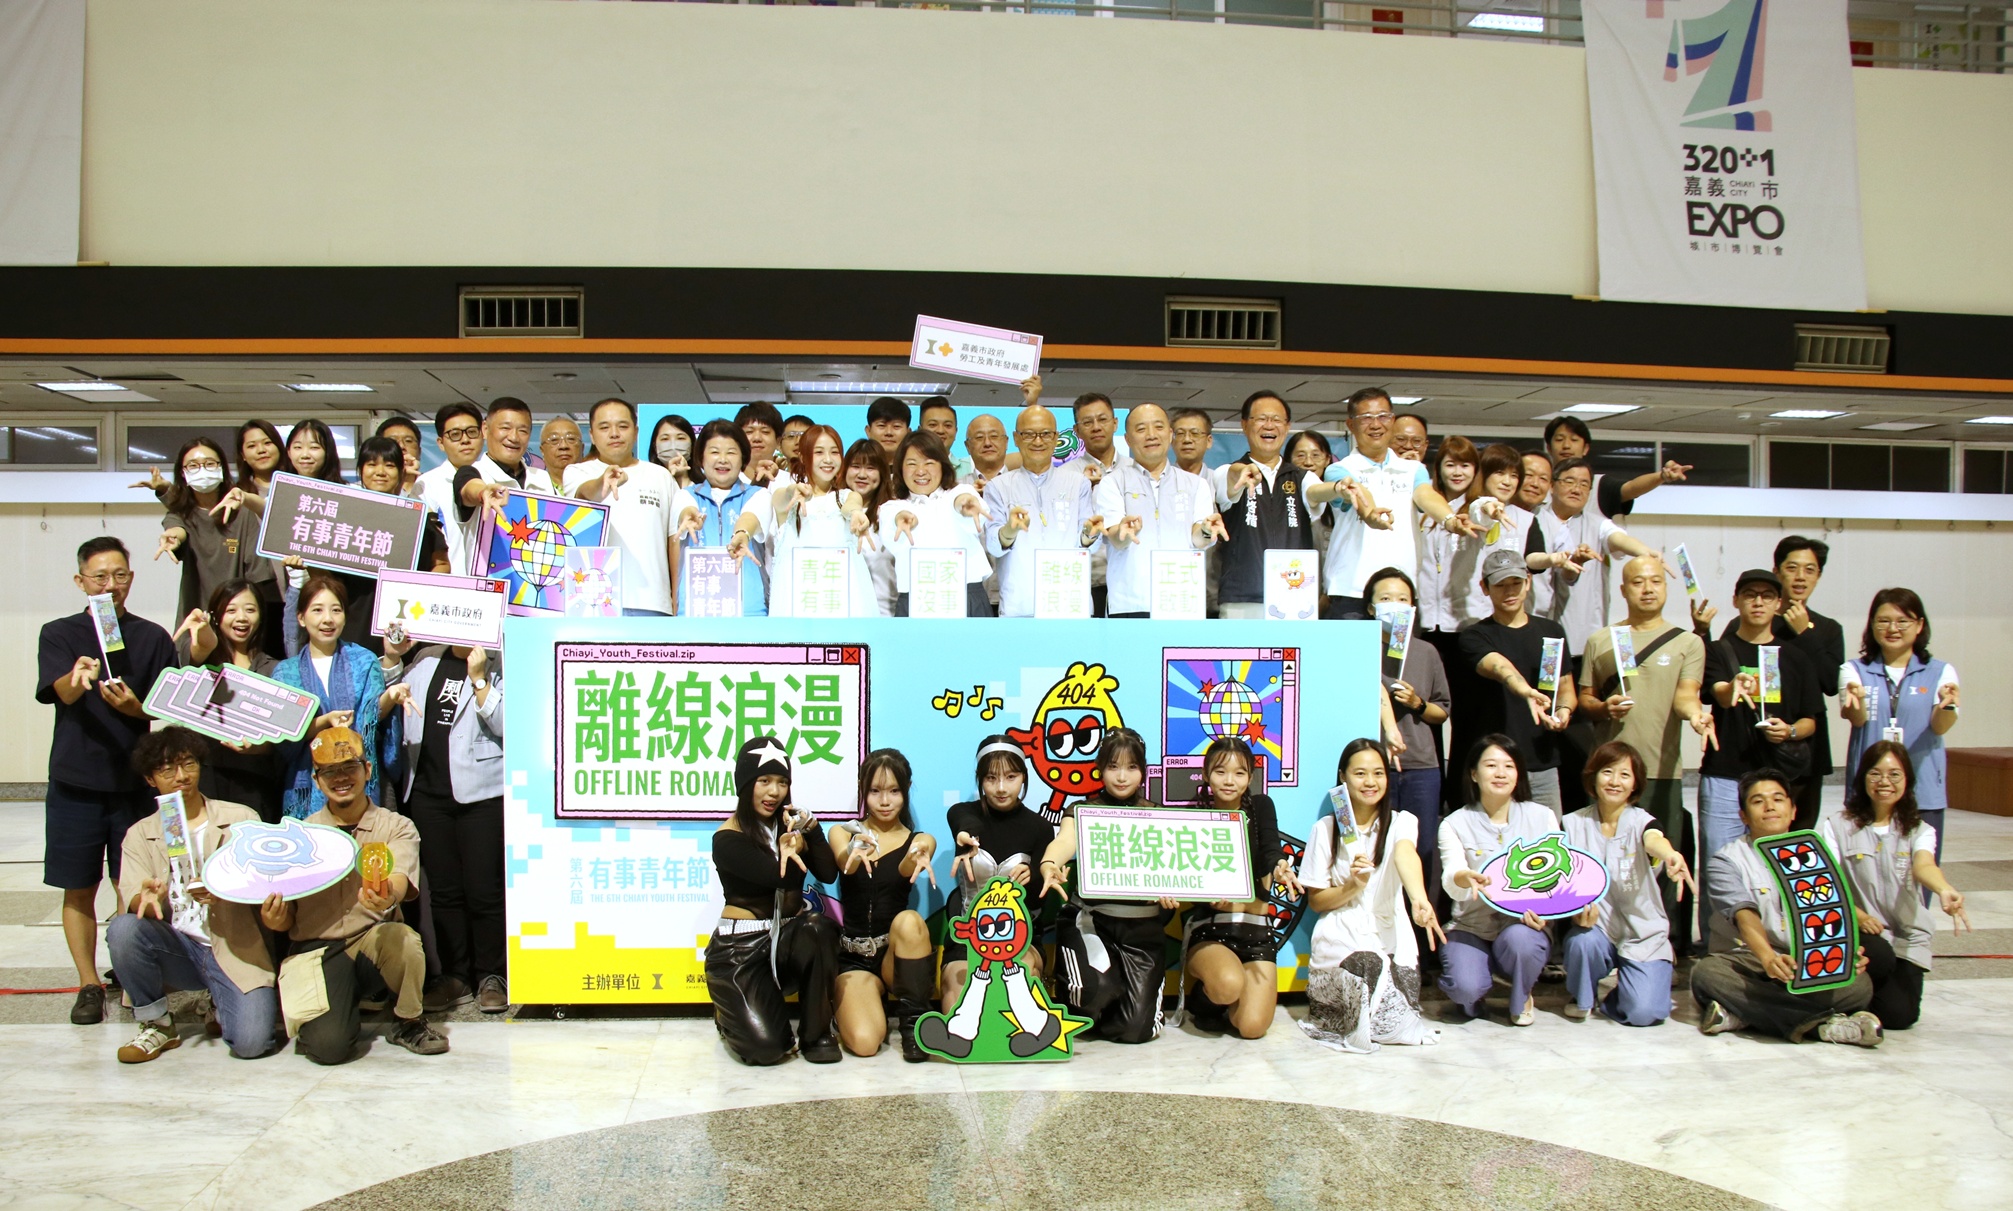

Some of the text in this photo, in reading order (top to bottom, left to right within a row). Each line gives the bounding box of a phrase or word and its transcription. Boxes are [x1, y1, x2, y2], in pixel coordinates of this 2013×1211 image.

[1686, 200, 1786, 241] EXPO
[960, 342, 1006, 359] 嘉義市政府
[297, 493, 340, 519] 第六屆
[291, 514, 395, 558] 有事青年節
[289, 541, 387, 568] THE 6TH CHIAYI YOUTH FESTIVAL
[692, 556, 736, 574] 第六屆
[801, 558, 842, 584] 青年
[917, 560, 959, 585] 國家
[1159, 561, 1199, 585] 正式
[692, 574, 722, 597] 有事
[429, 602, 484, 621] 嘉義市政府
[801, 588, 842, 614] 有事
[917, 588, 958, 614] 沒事
[562, 648, 695, 660] Chiayi_Youth_Festival.zip
[250, 693, 263, 702] Not
[263, 698, 284, 710] Found
[1056, 682, 1097, 705] 404
[573, 669, 845, 766] 離線浪漫
[574, 769, 737, 797] OFFLINE ROMA
[1087, 821, 1238, 874] 離線浪漫
[569, 857, 584, 905] 第六屆
[588, 856, 711, 890] 有事青年節
[1090, 872, 1205, 890] OFFLINE ROMANCE
[590, 893, 710, 903] THE 6TH CHIAYI YOUTH FESTIVAL
[983, 892, 1009, 907] 404
[581, 973, 641, 991] 主辦單位
[685, 972, 707, 983] 嘉義
